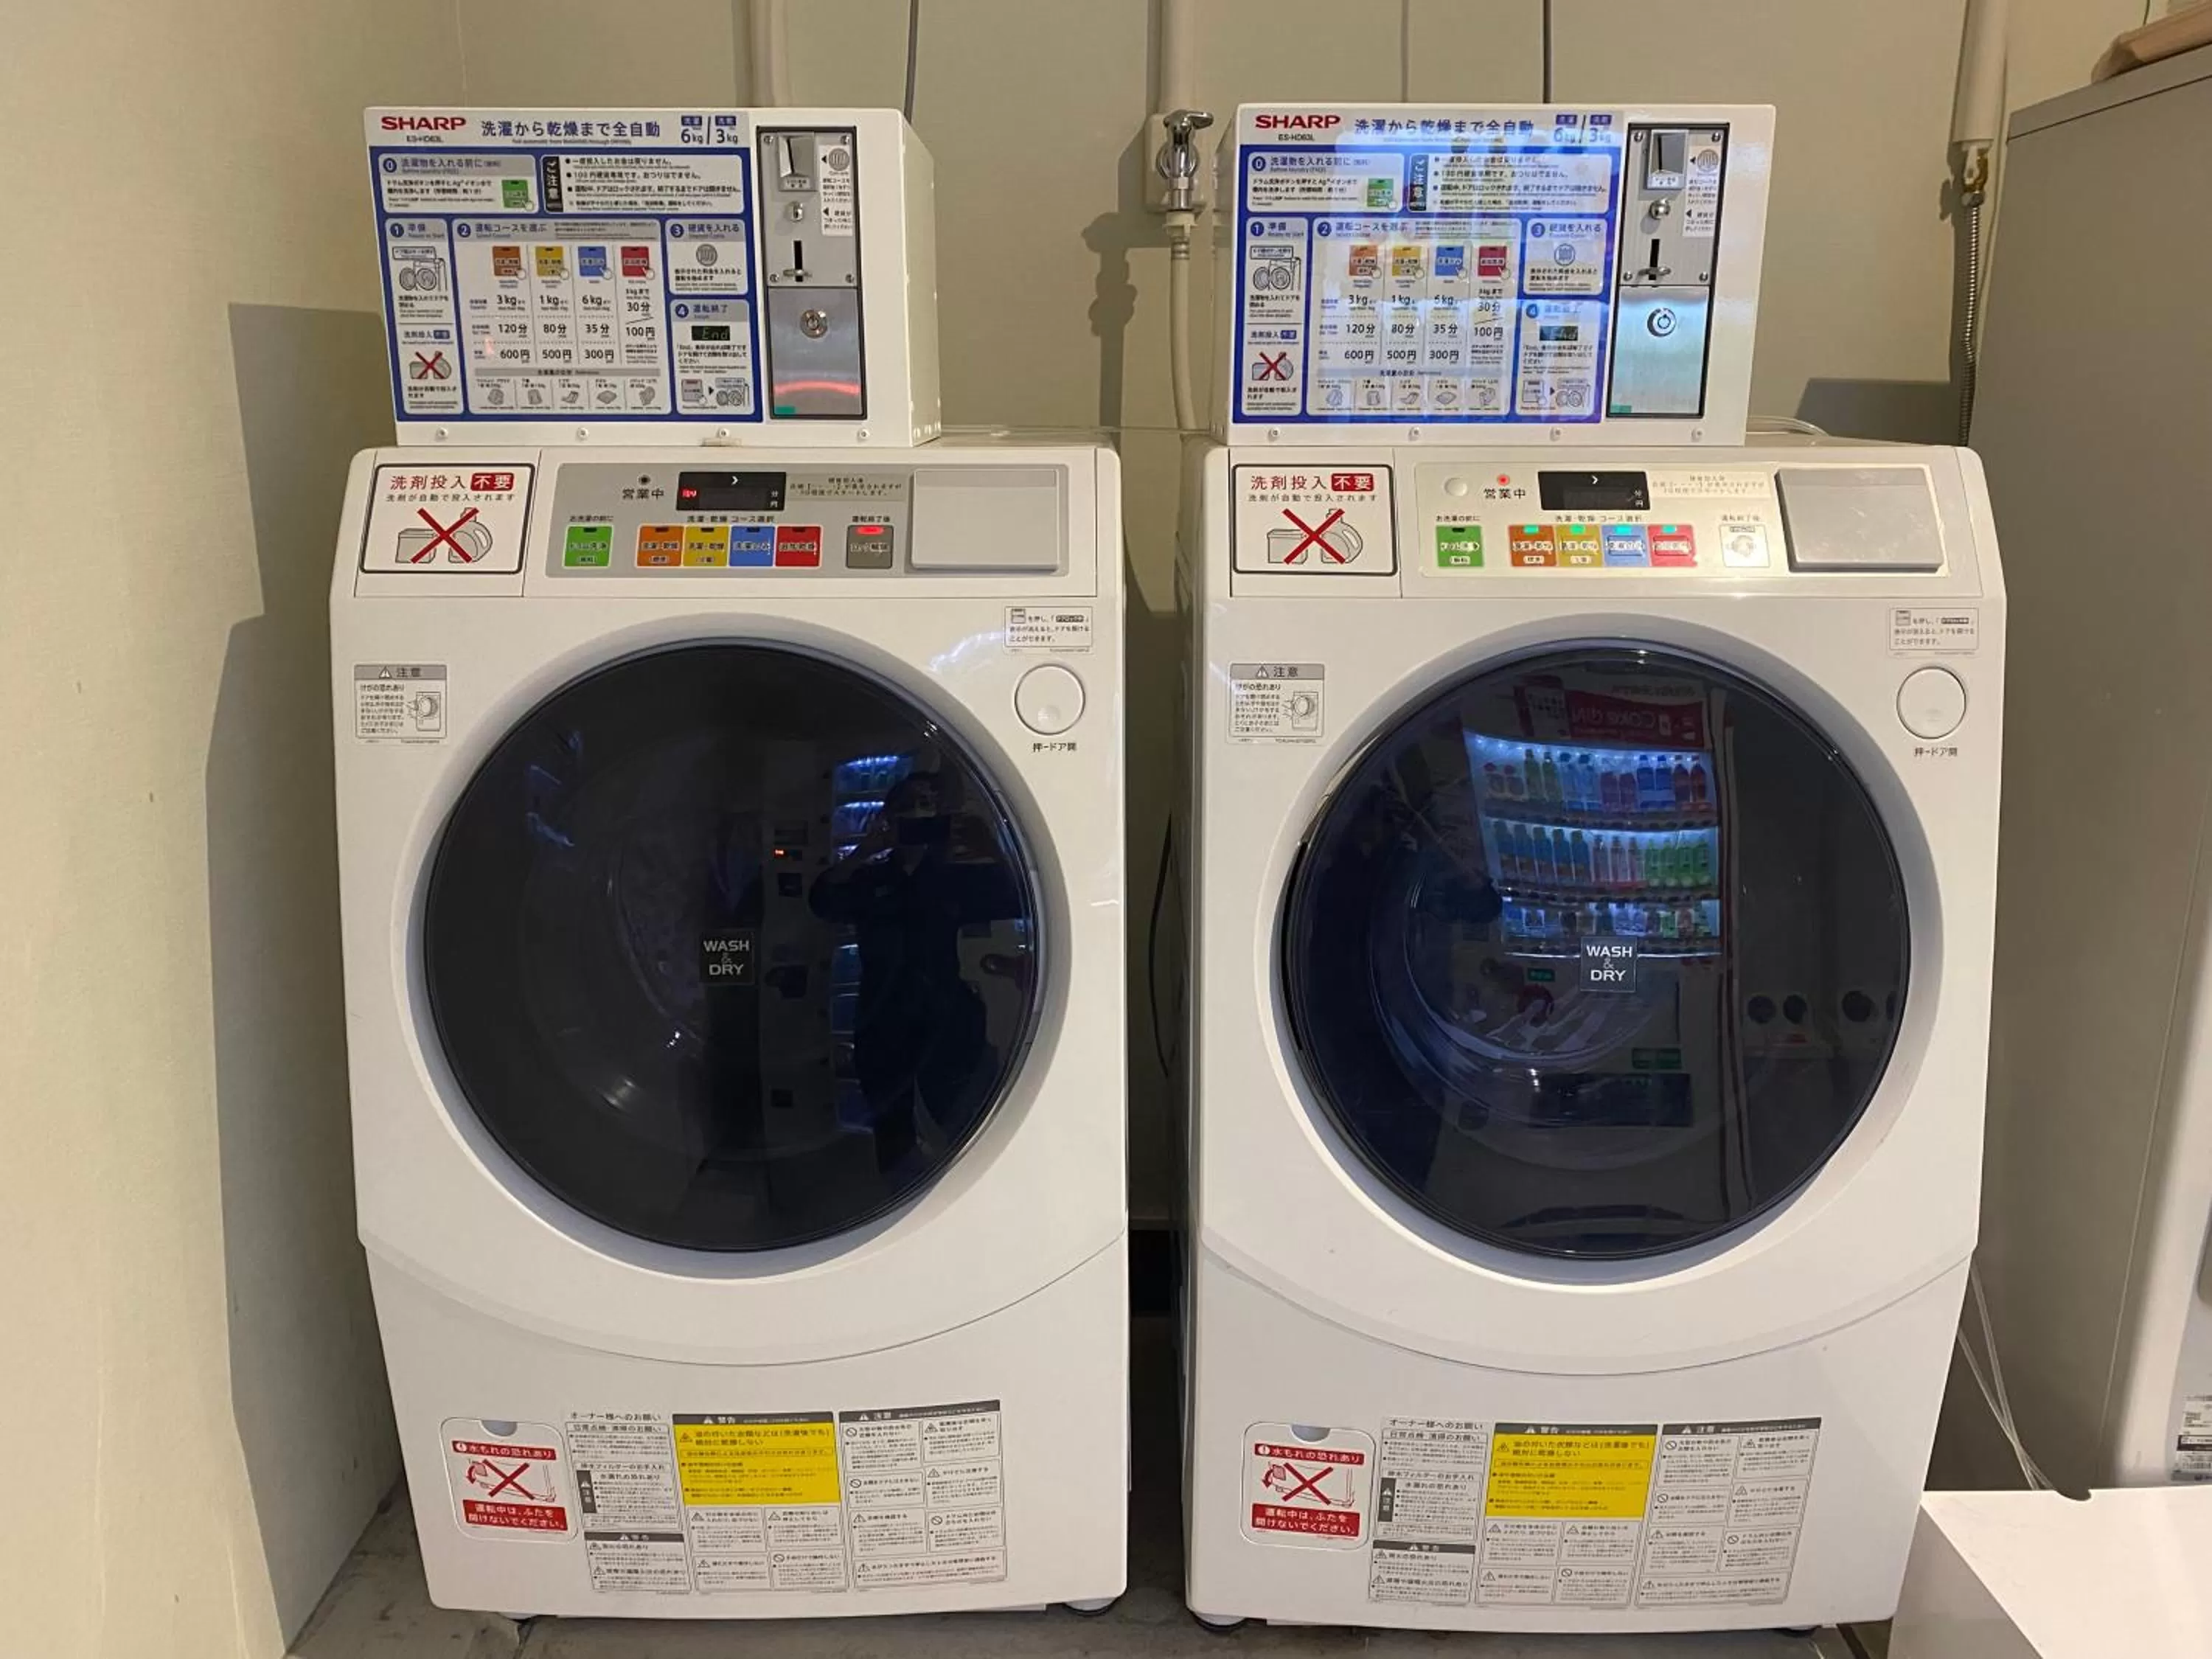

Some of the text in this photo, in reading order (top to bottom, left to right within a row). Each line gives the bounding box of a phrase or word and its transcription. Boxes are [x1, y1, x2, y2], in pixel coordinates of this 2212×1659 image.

[381, 116, 466, 131] SHARP
[1256, 115, 1341, 128] SHARP
[481, 120, 661, 137] 洗濯から乾燥まで全自動
[1354, 119, 1534, 136] 洗濯から乾燥まで全自動
[681, 128, 703, 143] 6kg
[717, 128, 737, 144] 3kg
[475, 223, 547, 232] 運転コースを選ぶ
[688, 223, 740, 233] 硬貨を入れる
[496, 295, 517, 305] 3kg
[539, 295, 560, 305] 1kg
[582, 295, 602, 305] 6kg
[1349, 294, 1368, 305] 3kg
[1391, 295, 1411, 305] 1kg
[627, 302, 651, 312] 30分
[1478, 302, 1500, 312] 30分
[498, 324, 527, 334] 120分
[543, 324, 567, 334] 80分
[585, 324, 610, 334] 35分
[626, 327, 655, 337] 100円
[702, 327, 728, 340] End
[1346, 324, 1375, 334] 120分
[1391, 324, 1415, 334] 80分
[1434, 324, 1458, 334] 35分
[1474, 327, 1503, 337] 100円
[500, 349, 530, 359] 600円
[542, 349, 572, 359] 500円
[585, 349, 614, 359] 300円
[1344, 350, 1374, 359] 600円
[1387, 350, 1416, 360] 500円
[1430, 350, 1459, 360] 300円
[390, 474, 512, 490] 洗剤投入 不要
[1251, 475, 1372, 490] 洗剤投入 不要
[386, 493, 515, 502] 洗剤が自動で投入されます
[622, 488, 664, 500] 営業中
[1248, 494, 1377, 502] 洗剤が自動で投入されます
[1484, 488, 1526, 500] 営業中
[1273, 666, 1298, 678] 注意
[703, 940, 749, 952] WASH
[1586, 945, 1632, 958] WASH
[709, 964, 744, 975] DRY
[1590, 970, 1627, 981] DRY
[571, 1412, 661, 1421] オーナー様へのお願い
[1390, 1419, 1483, 1430] オーナー様へのお願い
[469, 1444, 552, 1458] 水もれの恐れあり
[1271, 1447, 1360, 1463] 水もれの恐れあり
[475, 1503, 554, 1517] 運転中は、ふたを
[1265, 1507, 1347, 1523] 運転中は、ふたを
[468, 1513, 564, 1528] 開けないでください。
[1256, 1517, 1355, 1534] 開けないでください。
